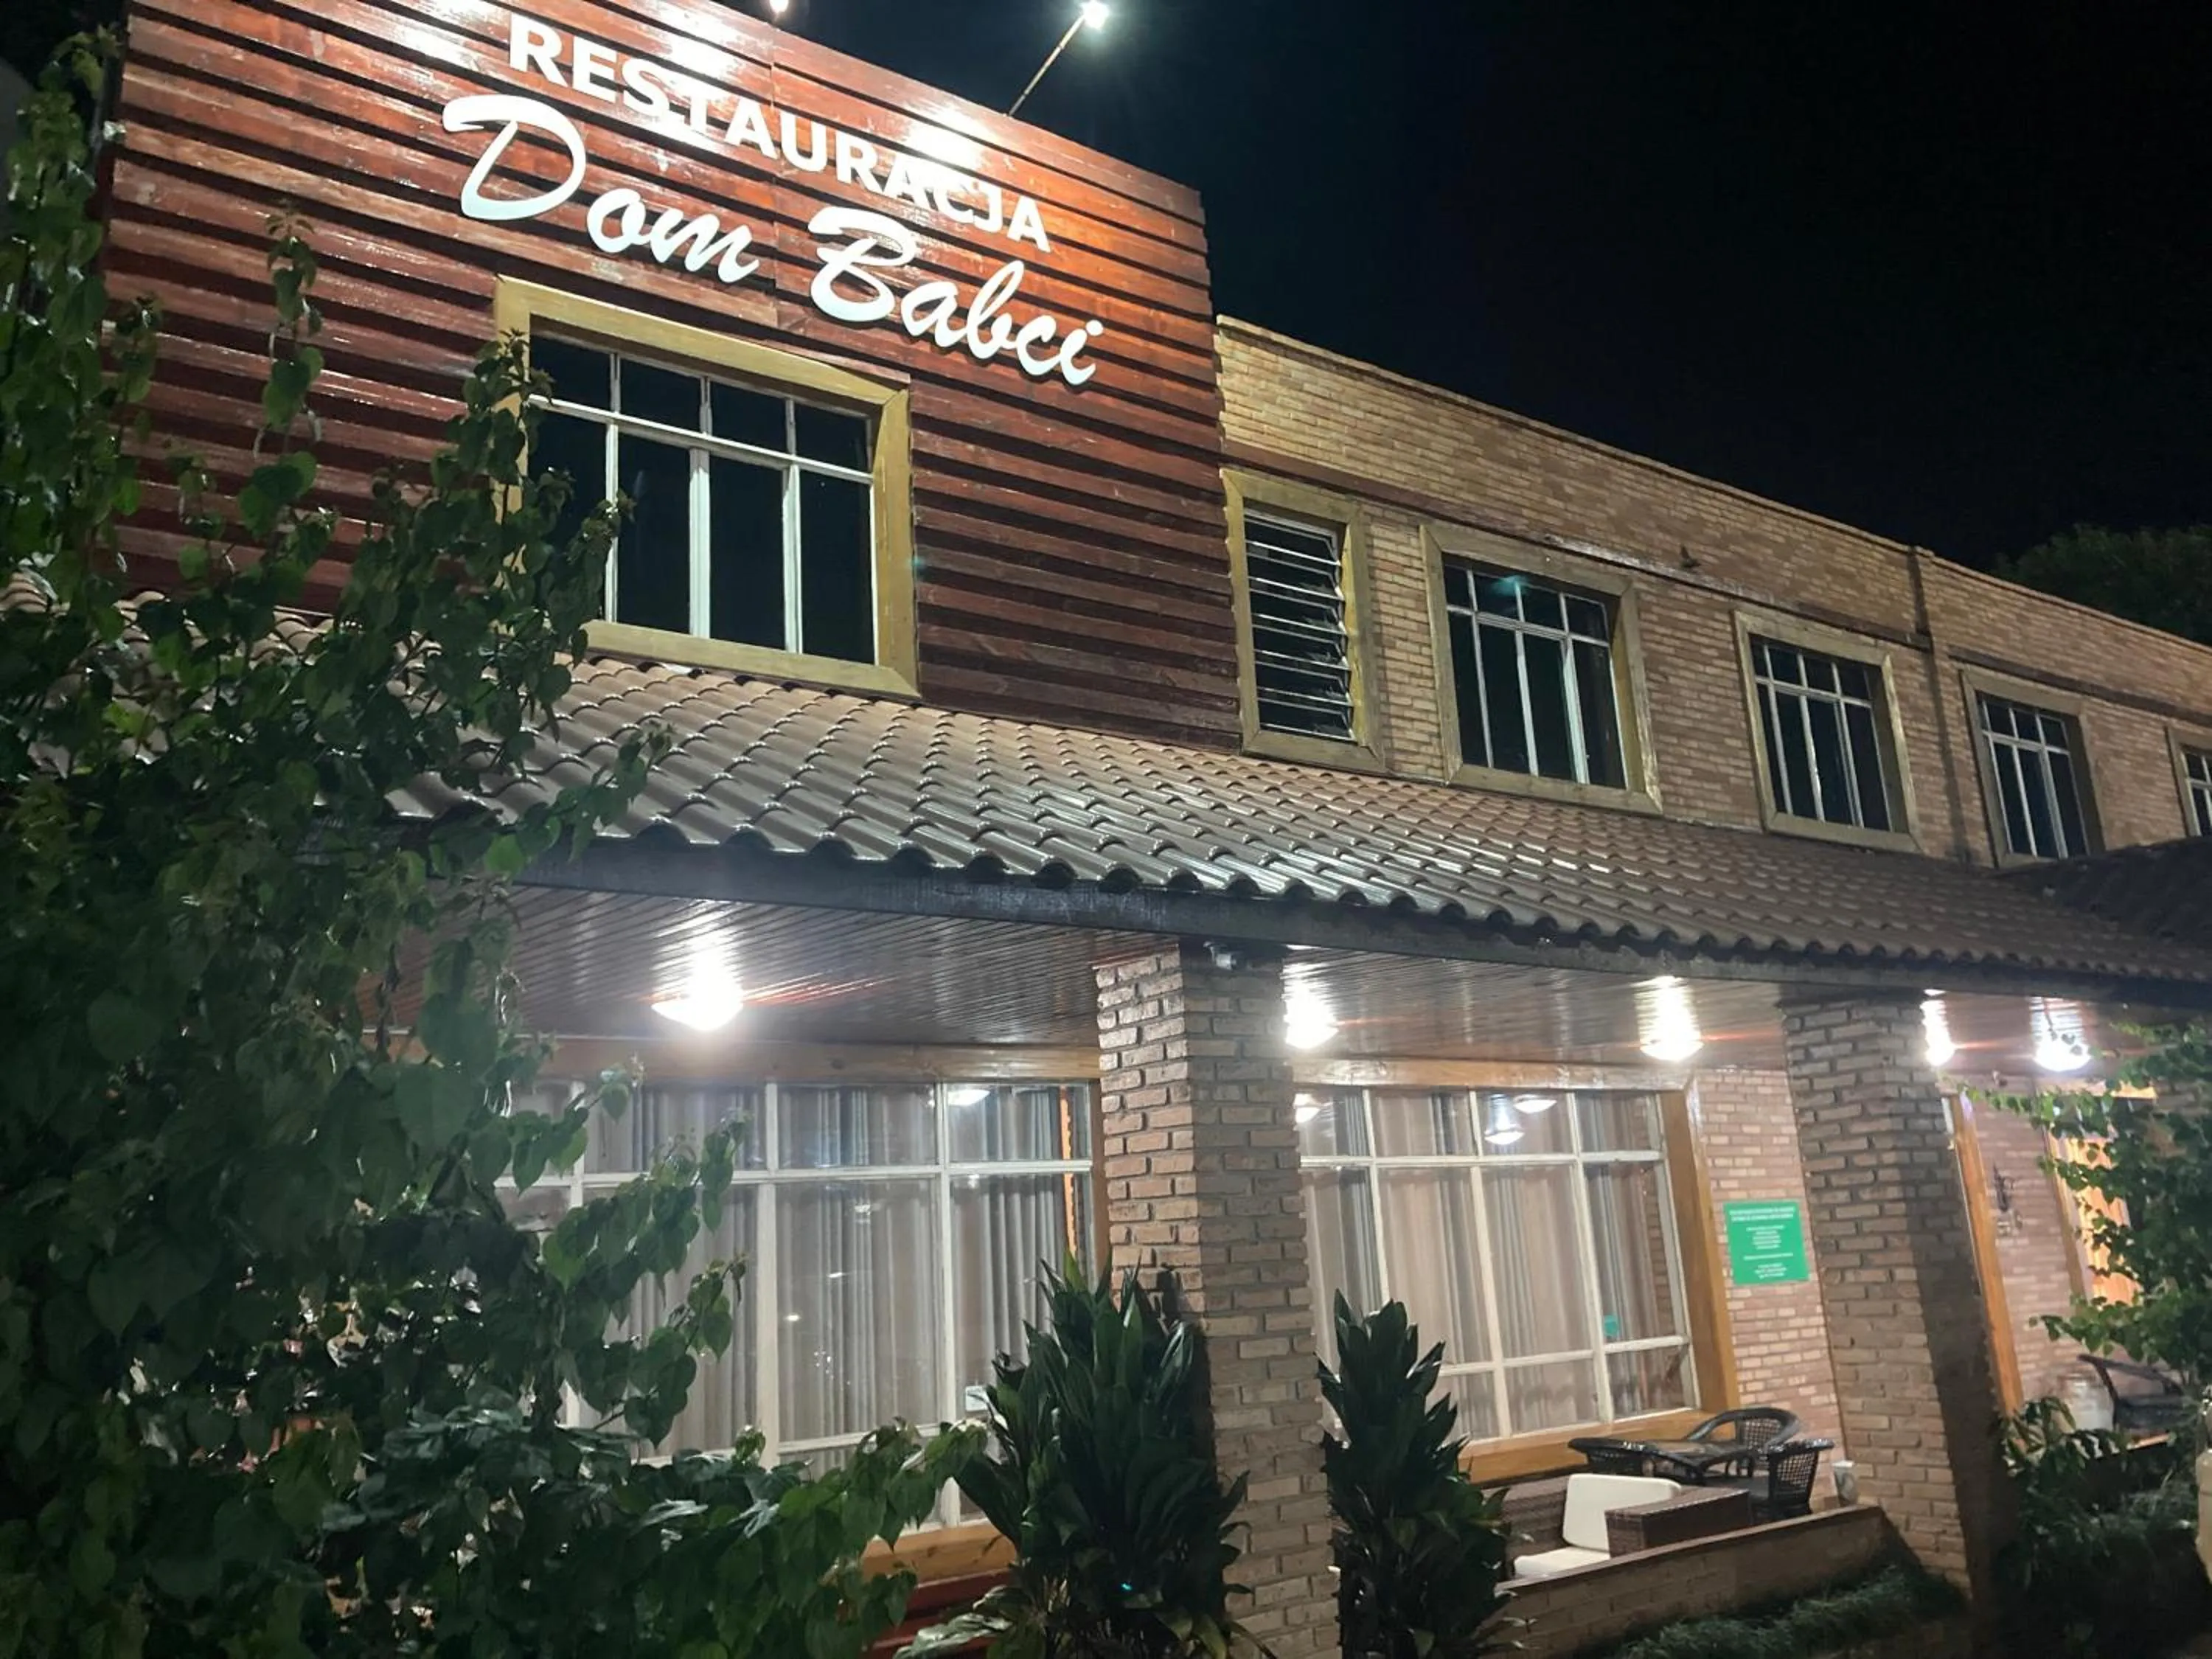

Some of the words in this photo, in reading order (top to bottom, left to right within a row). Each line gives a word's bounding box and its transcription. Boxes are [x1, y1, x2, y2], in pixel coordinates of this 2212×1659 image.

[442, 94, 759, 284] Dom
[808, 206, 1105, 386] Babci
[509, 13, 1051, 253] RESTAURACJA
